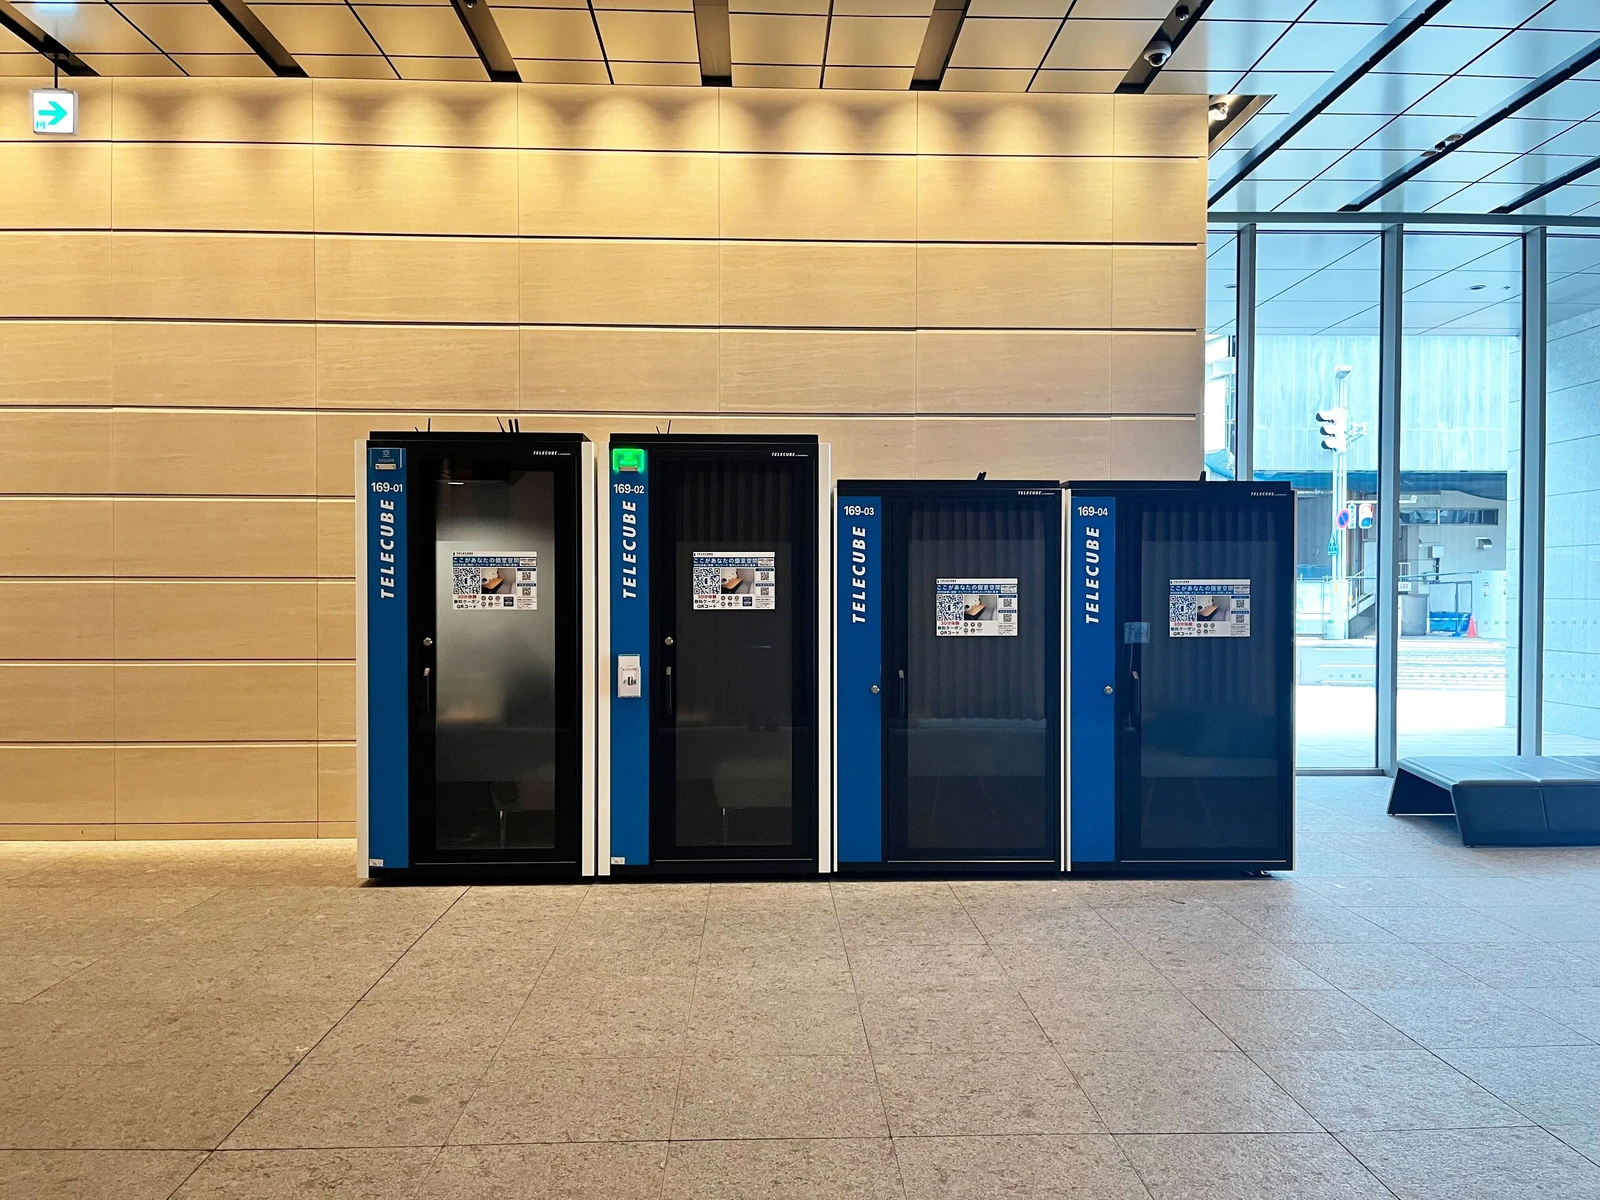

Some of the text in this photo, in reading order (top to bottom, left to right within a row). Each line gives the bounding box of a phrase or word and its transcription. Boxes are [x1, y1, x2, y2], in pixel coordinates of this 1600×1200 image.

[371, 482, 403, 492] 169-01
[613, 484, 645, 494] 169-02
[844, 505, 875, 516] 169-03
[1077, 506, 1108, 517] 169-04
[380, 499, 395, 599] TELECUBE
[622, 500, 637, 599] TELECUBE
[852, 526, 866, 624] TELECUBE
[1085, 526, 1100, 624] TELECUBE
